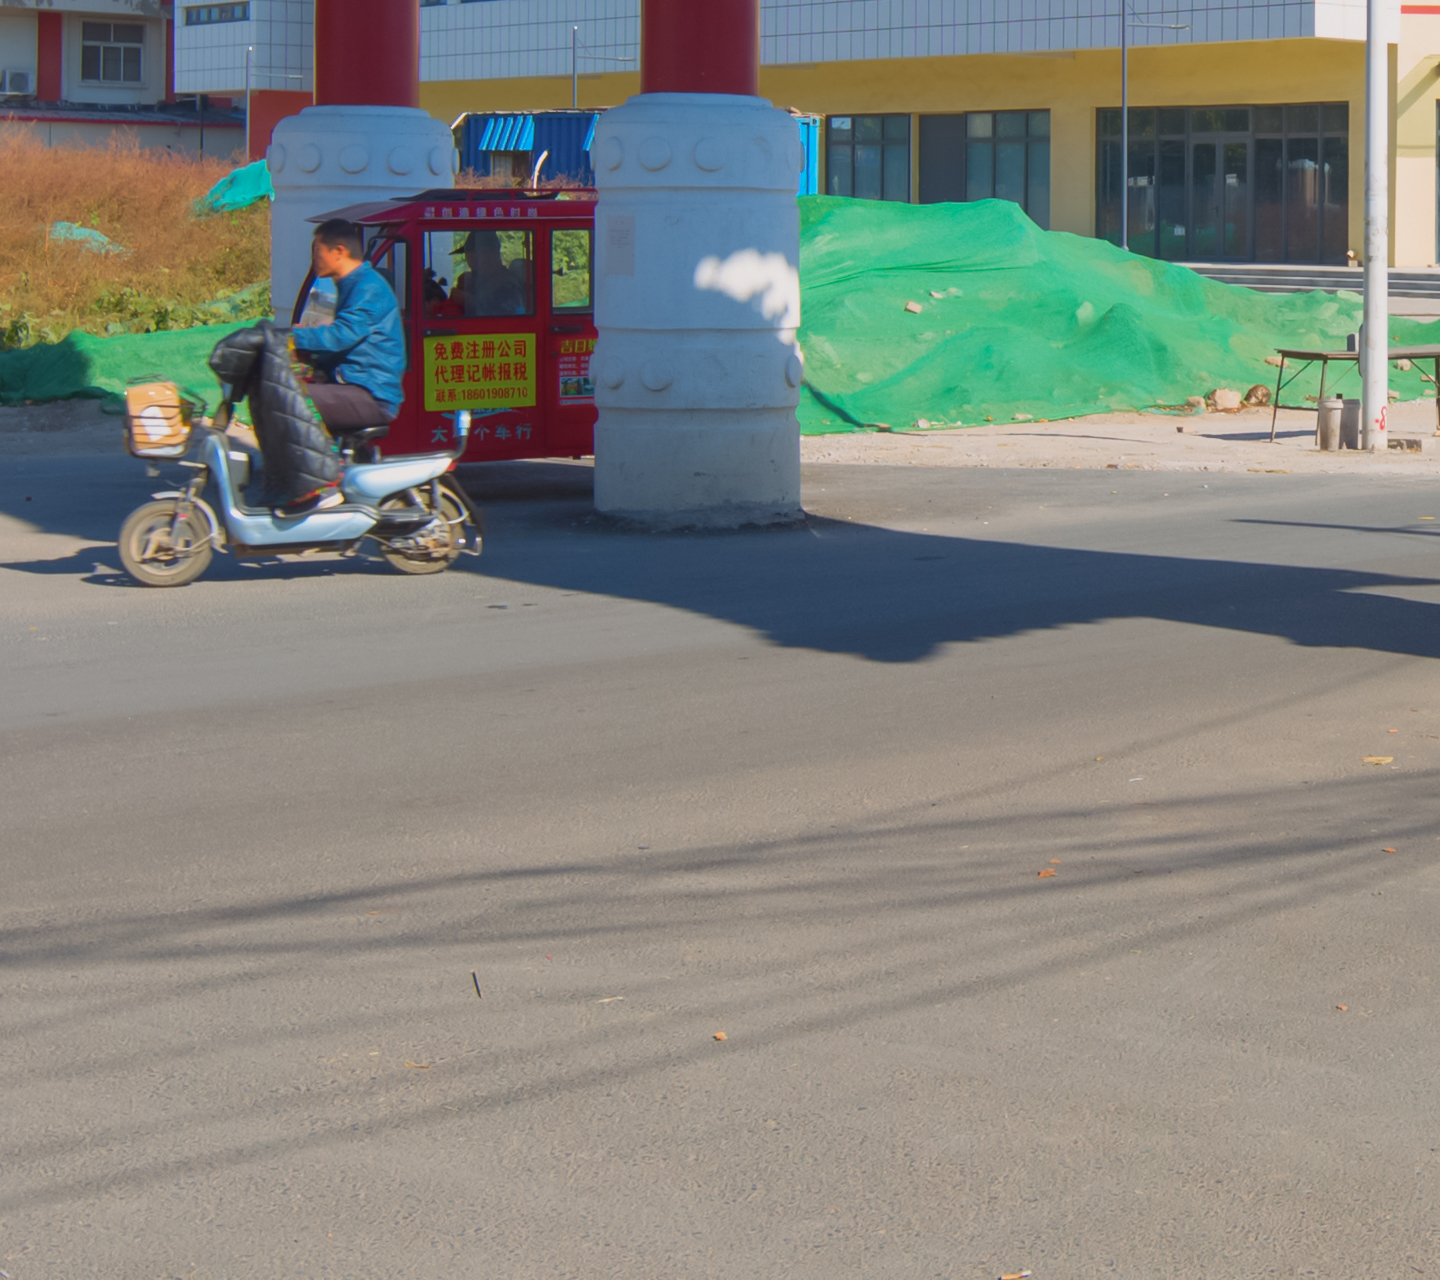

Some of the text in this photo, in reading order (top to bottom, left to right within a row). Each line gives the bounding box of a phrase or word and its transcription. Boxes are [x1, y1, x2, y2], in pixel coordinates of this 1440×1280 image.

[434, 340, 527, 360] 免费注册公司
[434, 362, 528, 384] 代理记帐报税
